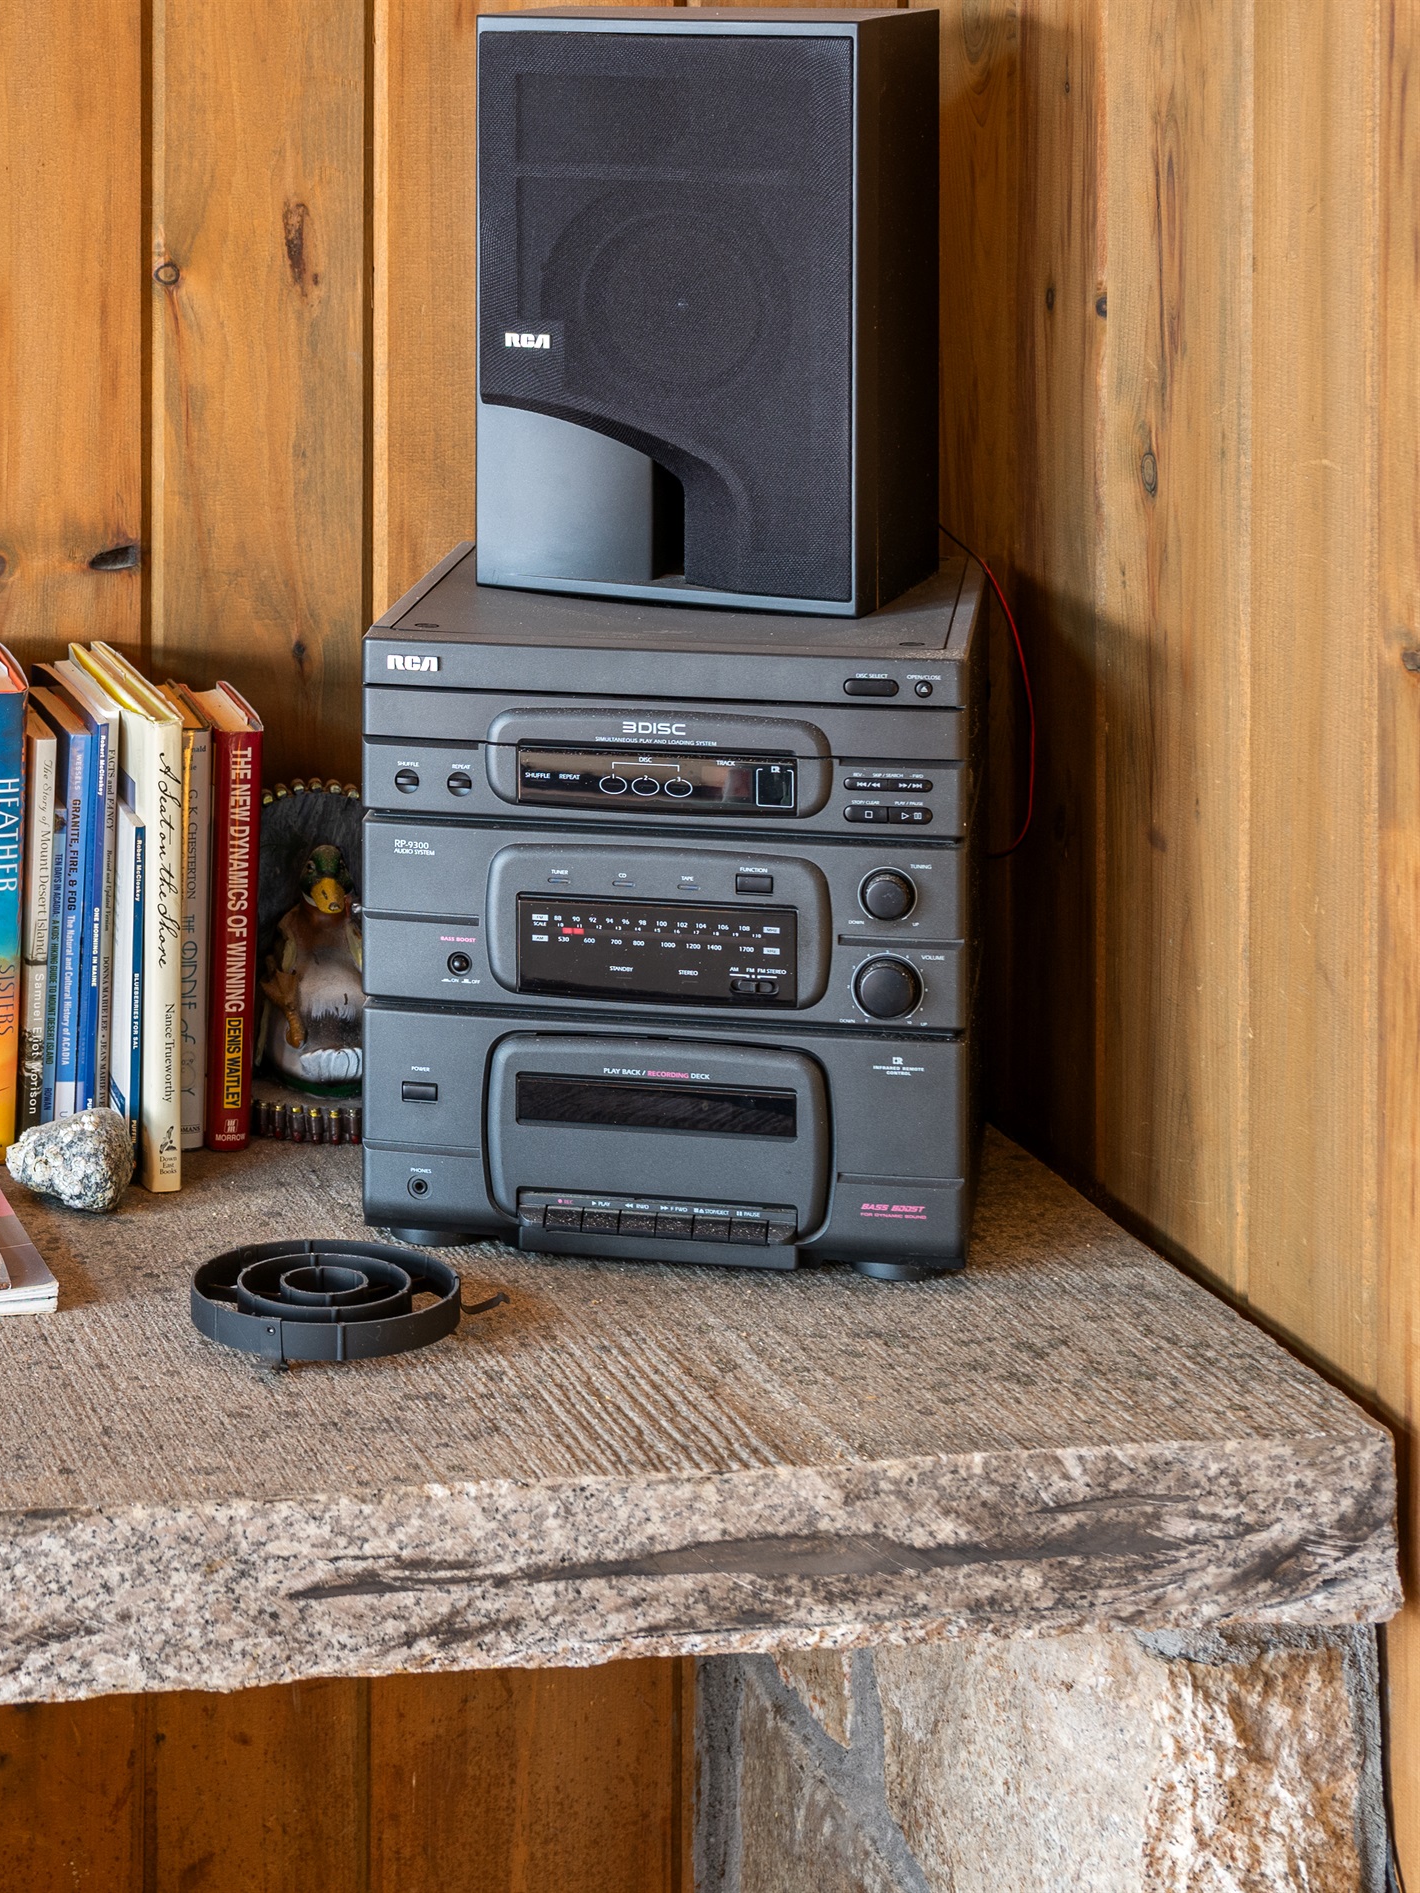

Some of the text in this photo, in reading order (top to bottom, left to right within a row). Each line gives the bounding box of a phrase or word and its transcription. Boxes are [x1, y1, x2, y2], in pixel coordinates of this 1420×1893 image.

[505, 332, 550, 349] RCA
[387, 654, 439, 672] RCA
[622, 721, 686, 736] 3DISC
[594, 736, 638, 744] SIMULTANEOUS
[397, 760, 420, 768] SHUFFLE
[186, 790, 198, 900] G. K. CHESTERTON
[394, 839, 430, 850] RP-9300
[34, 760, 53, 957] The Story of Mount Desert Island
[157, 752, 182, 969] A Seat on the Shore
[134, 864, 142, 902] McCloskey
[224, 746, 252, 1013] THE NEW DYNAMICS OF WINNING
[61, 754, 82, 1066] WESSELS GRANITE, FIRE, & FOG The Natural and Cultural History of ACADIA
[132, 973, 140, 1020] BLUEBERRIES
[28, 973, 45, 1114] Samuel Eliot Morison
[162, 1003, 176, 1104] Nance Trueworthy
[225, 1018, 242, 1108] DENIS WAITLEY
[622, 1068, 641, 1076] BACK
[647, 1070, 690, 1079] RECORDING
[690, 1072, 710, 1080] DECK
[215, 1133, 246, 1142] MORROW
[704, 1208, 730, 1216] STOP/EJECT
[743, 1210, 761, 1218] PAUSE
[861, 1203, 926, 1213] BASS BOOST
